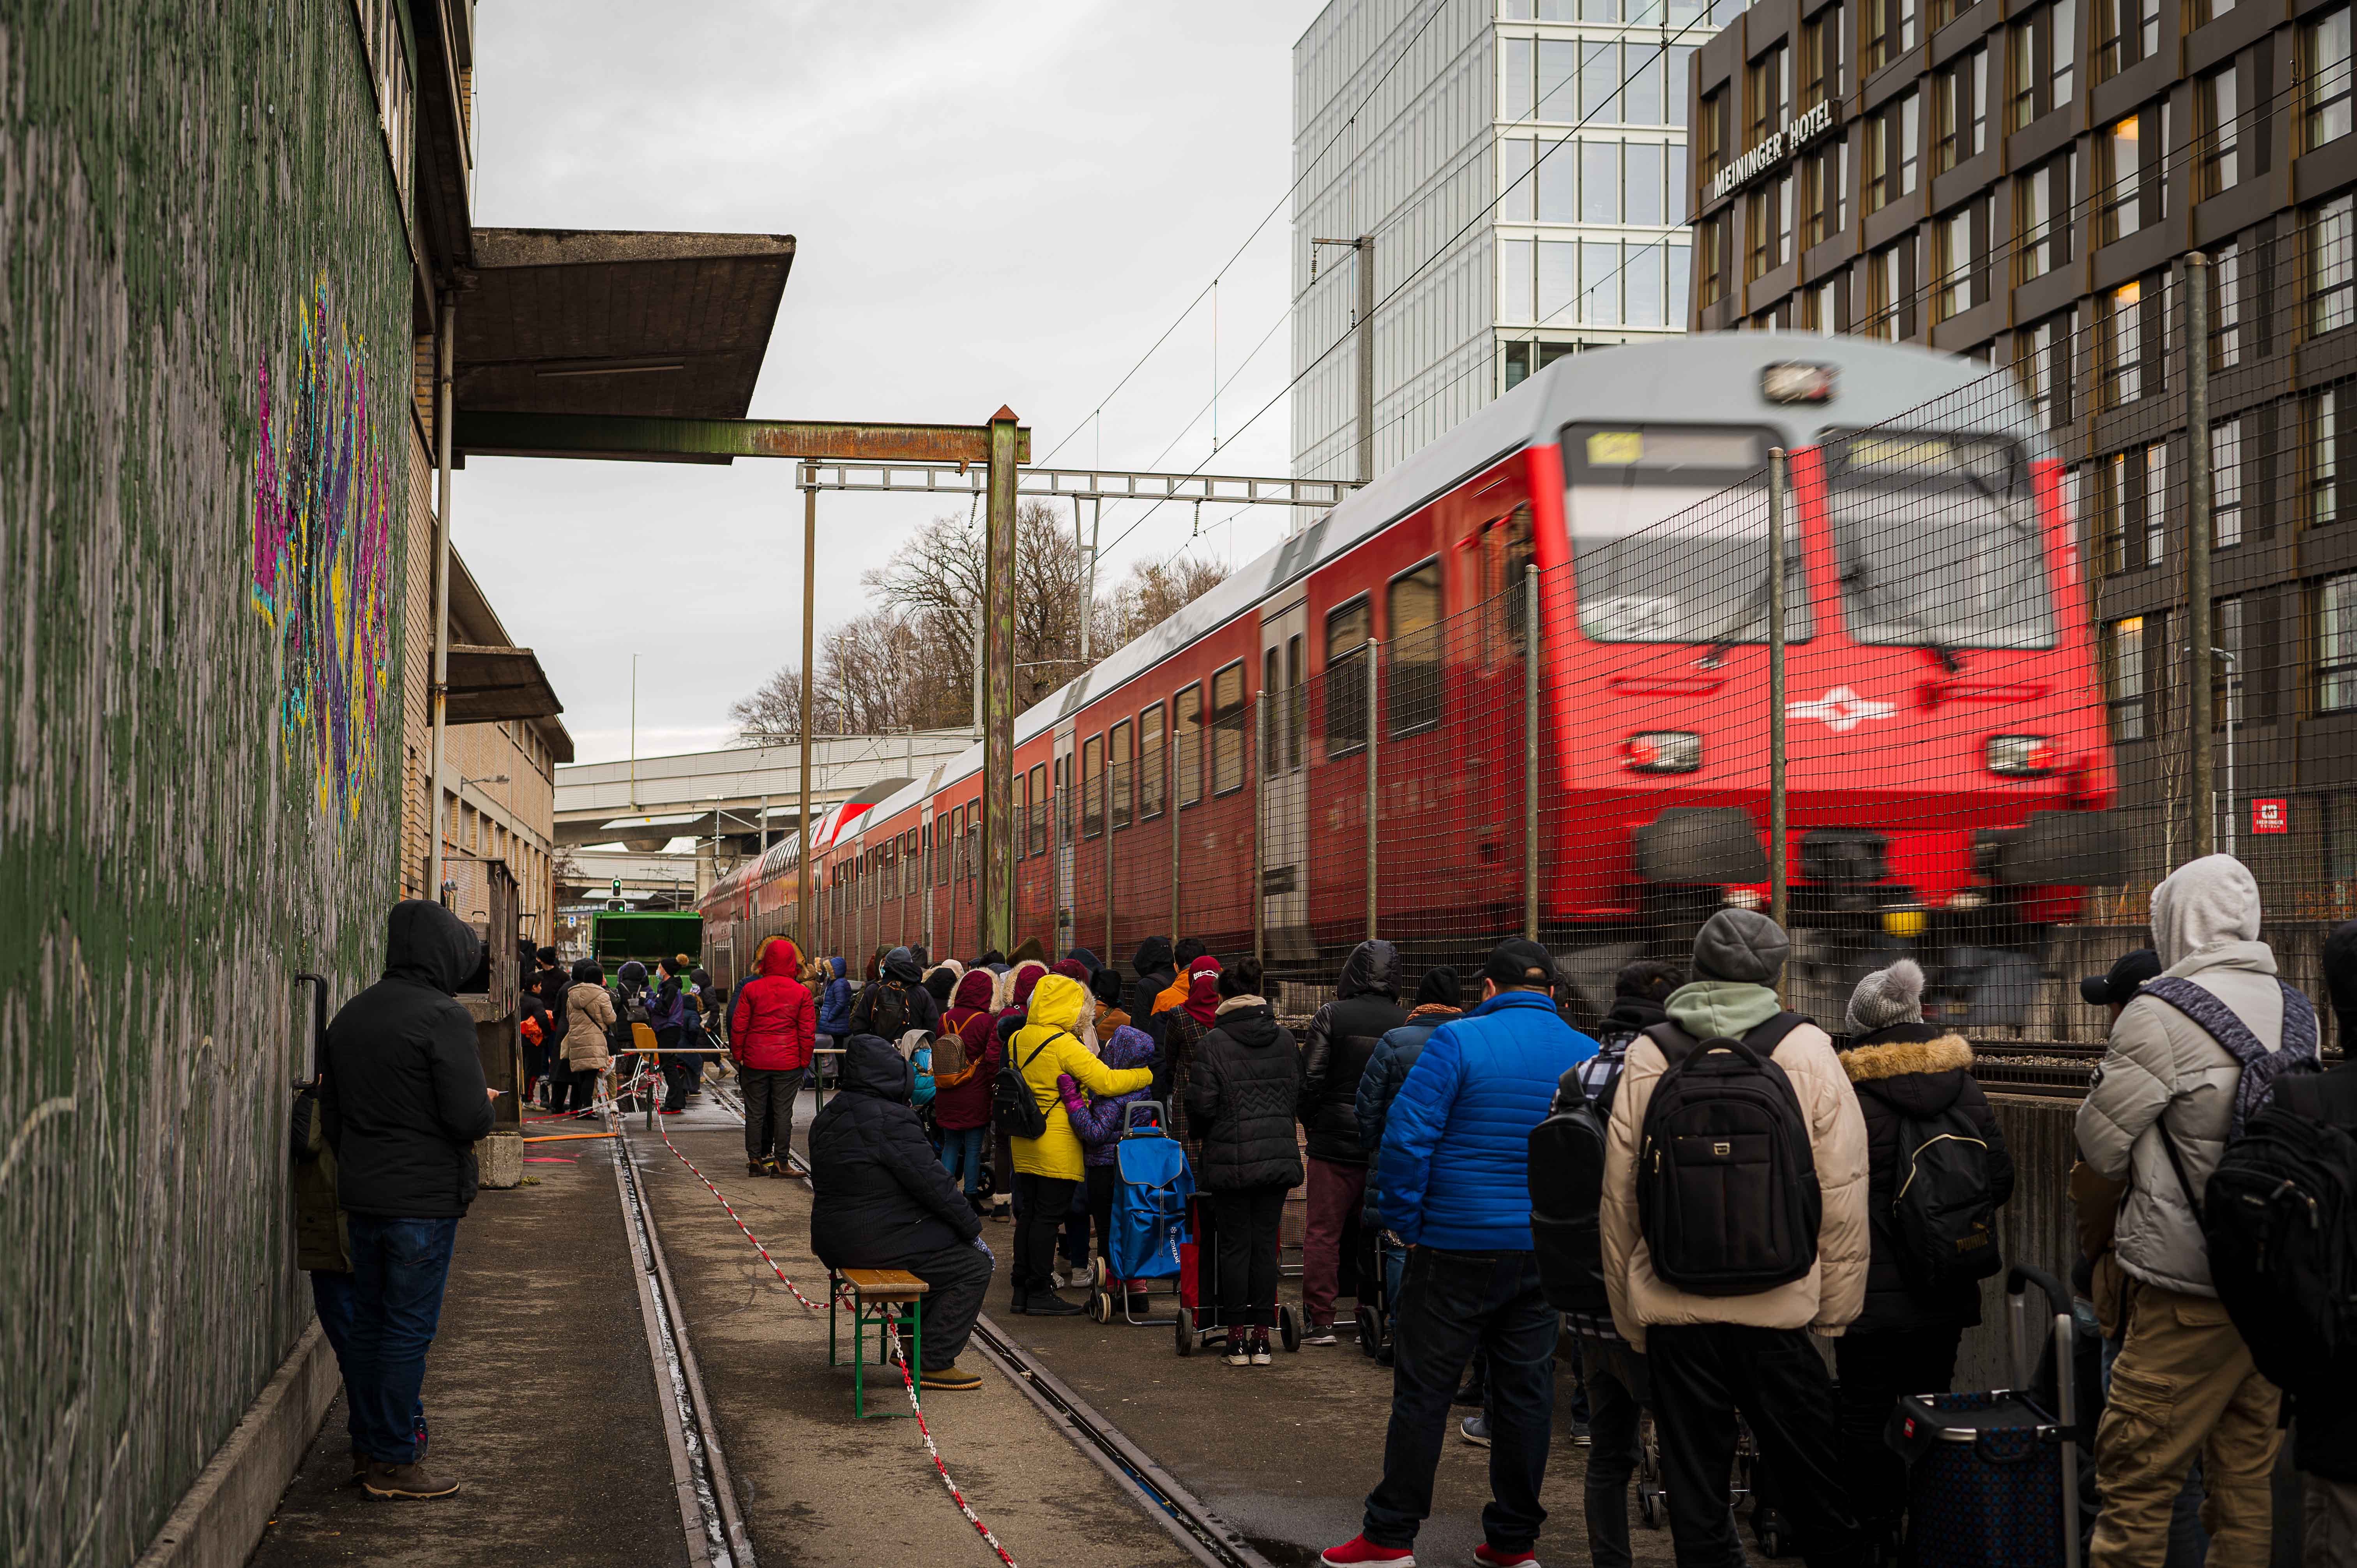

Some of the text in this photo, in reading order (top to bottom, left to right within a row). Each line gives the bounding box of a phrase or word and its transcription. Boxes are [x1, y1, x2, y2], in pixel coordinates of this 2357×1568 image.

[1714, 99, 1832, 200] MEININGER HOTEL
[1170, 1235, 1180, 1264] ISOTHERME
